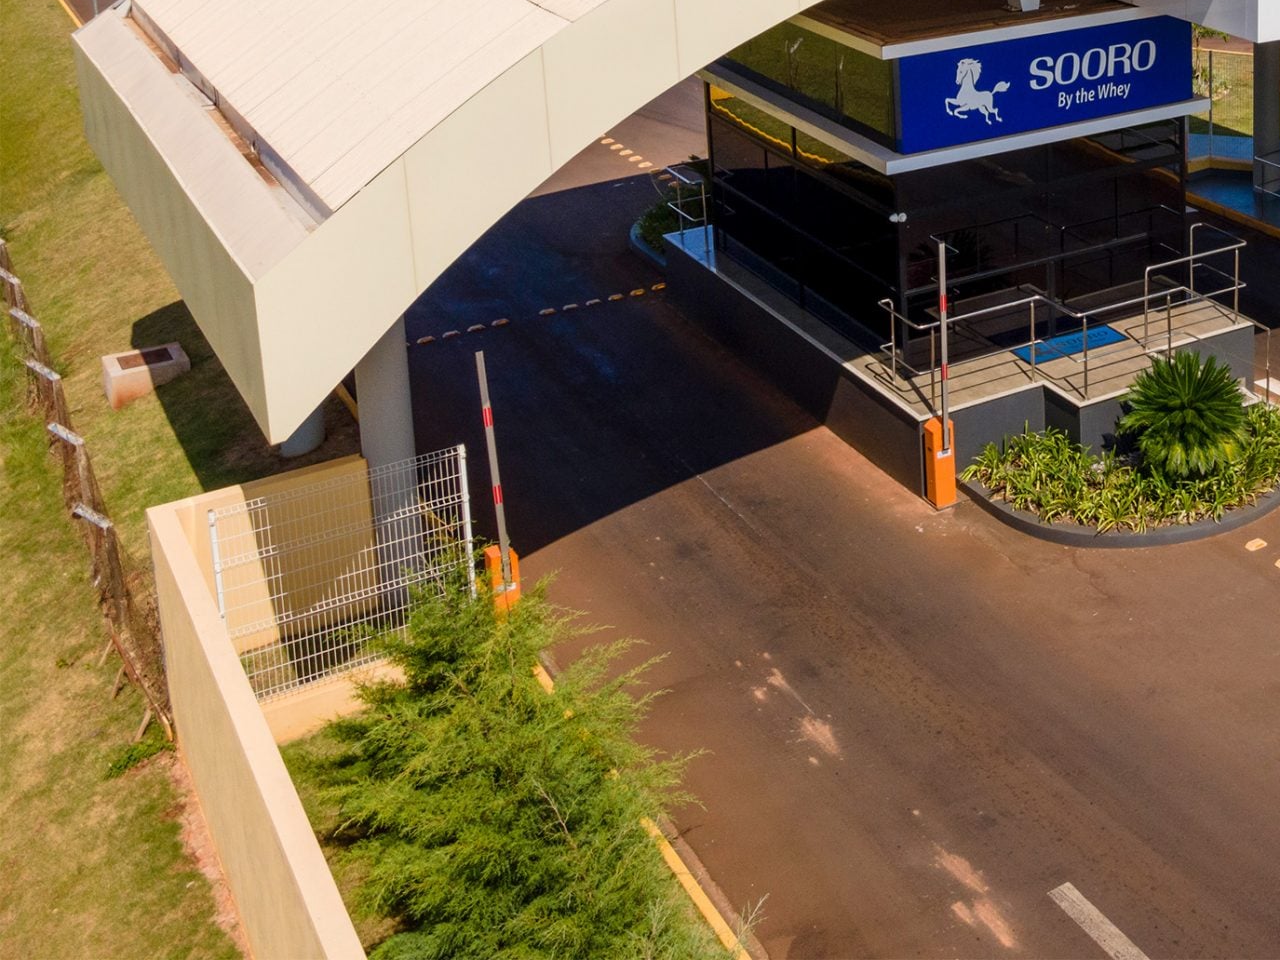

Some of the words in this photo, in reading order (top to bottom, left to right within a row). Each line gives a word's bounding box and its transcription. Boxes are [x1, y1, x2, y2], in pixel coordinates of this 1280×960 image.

[1029, 39, 1157, 90] SOORO
[1057, 91, 1073, 110] By
[1075, 87, 1095, 104] the
[1097, 82, 1131, 99] Whey
